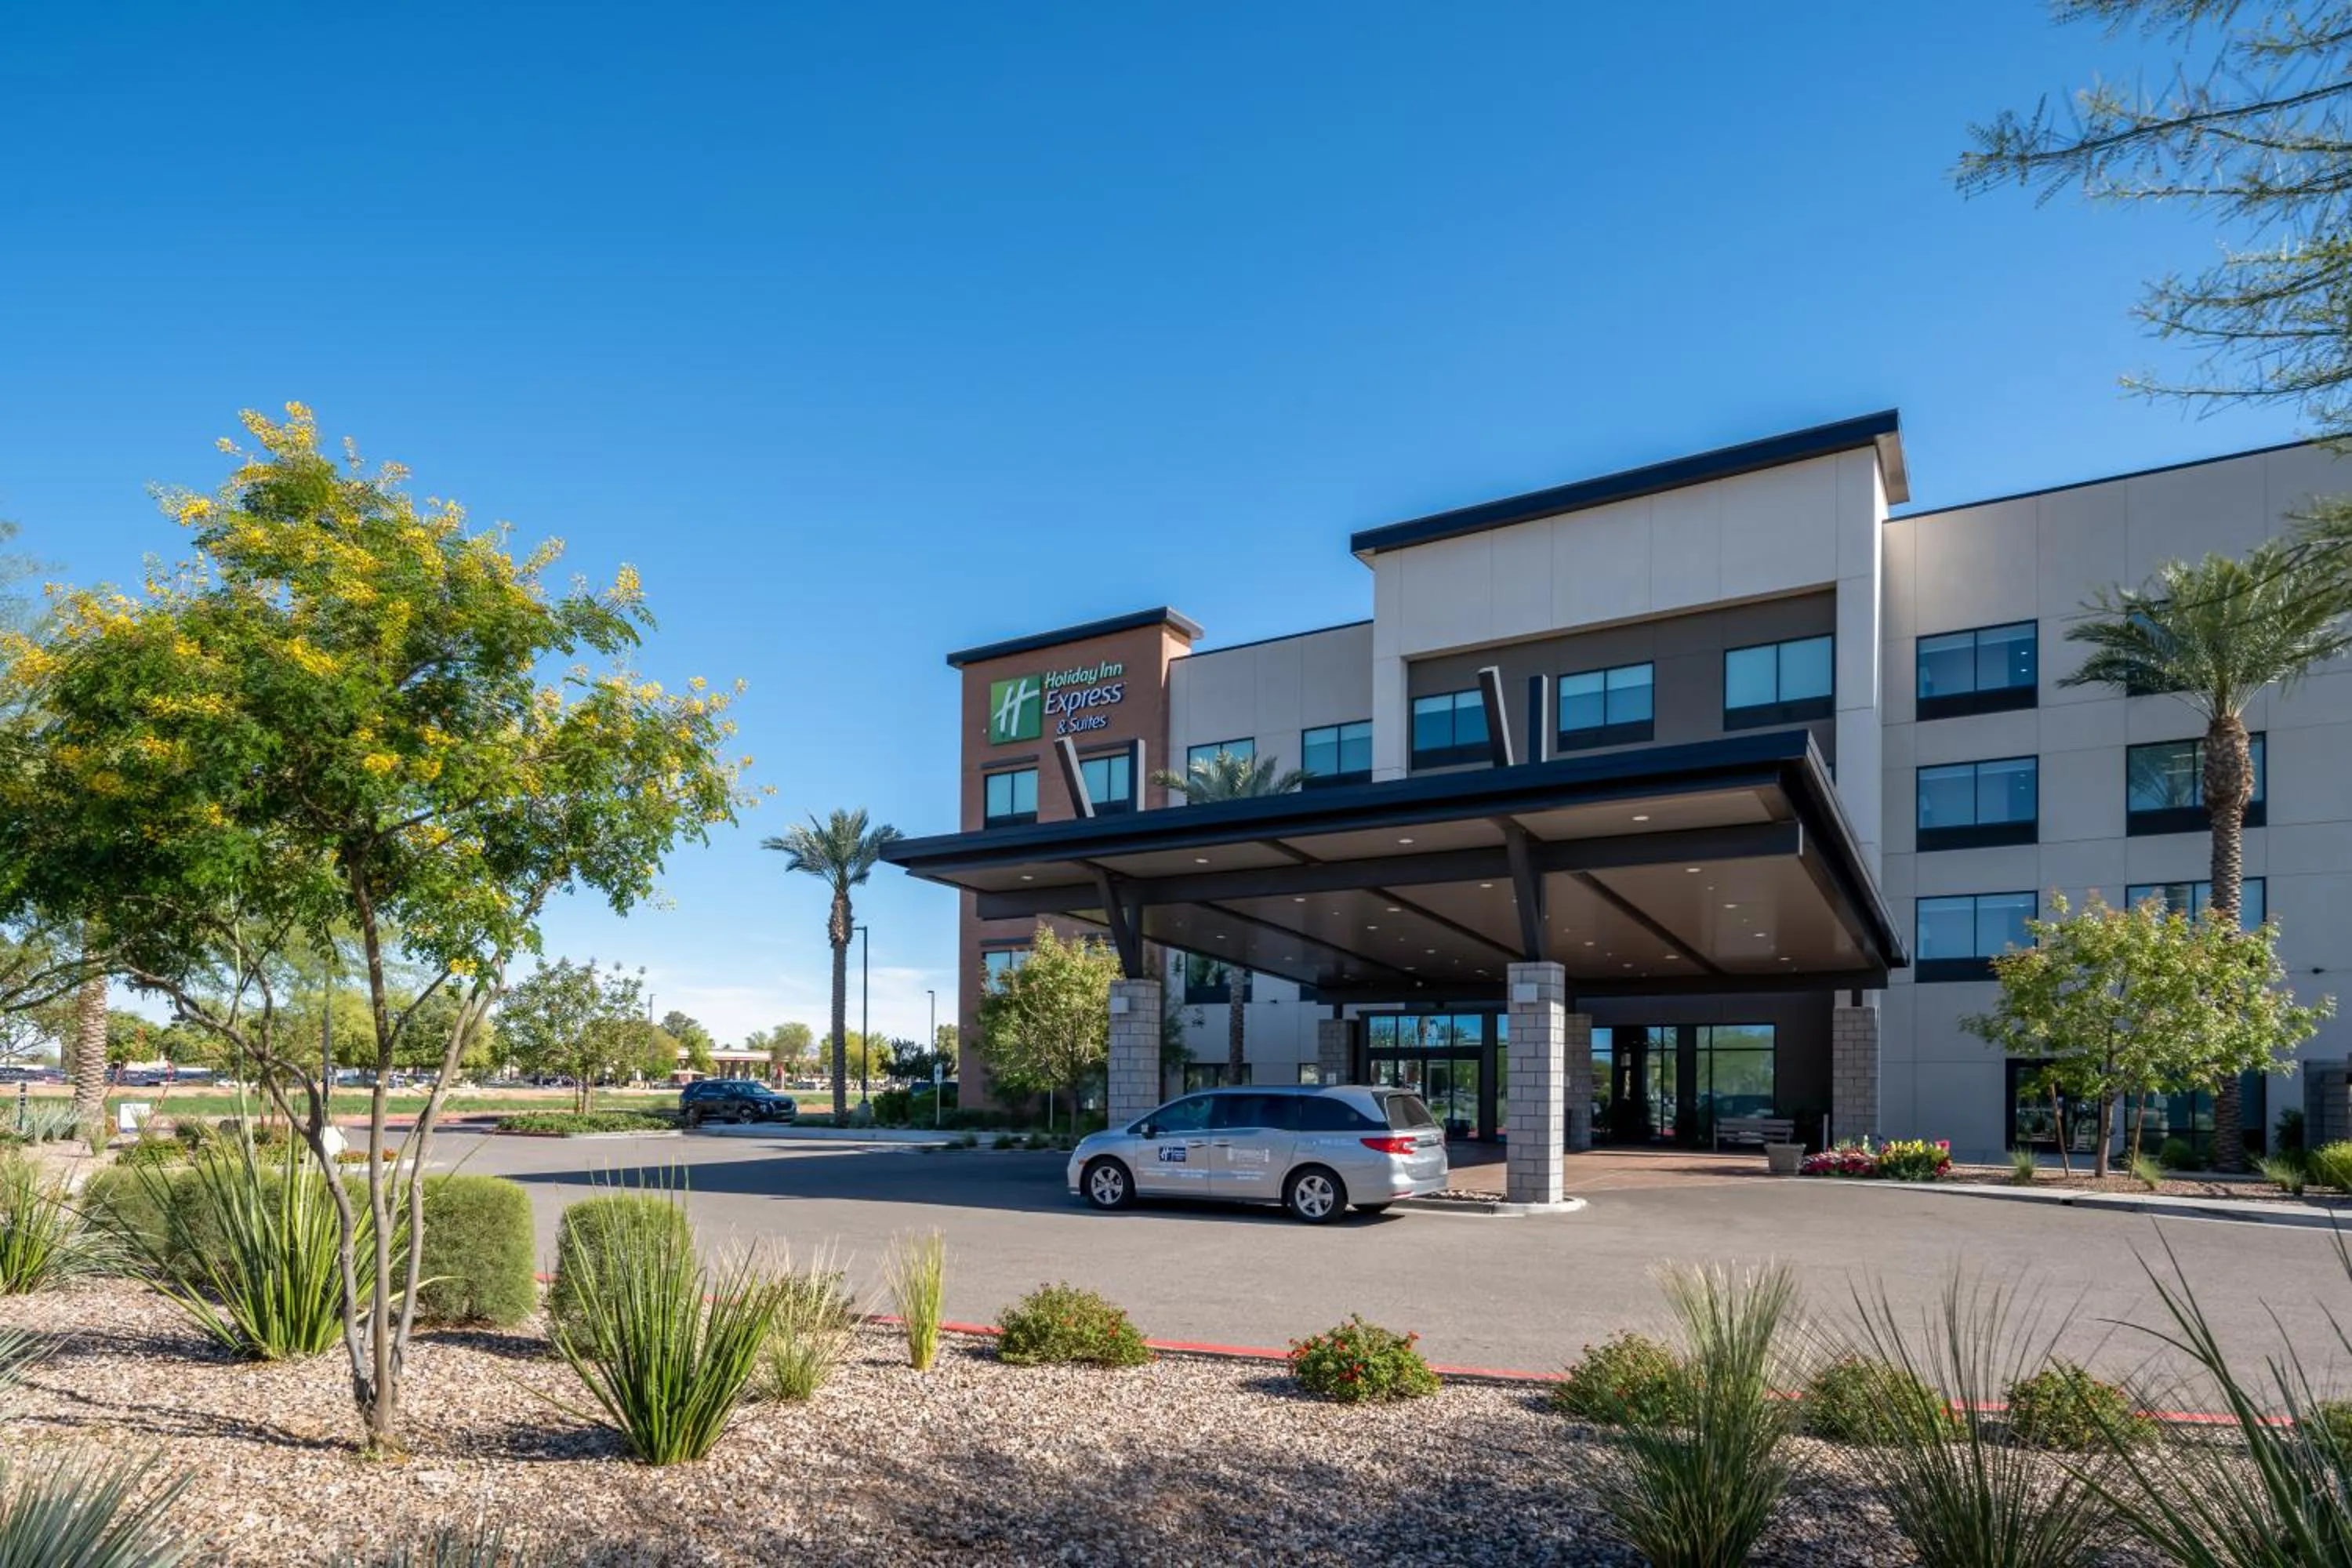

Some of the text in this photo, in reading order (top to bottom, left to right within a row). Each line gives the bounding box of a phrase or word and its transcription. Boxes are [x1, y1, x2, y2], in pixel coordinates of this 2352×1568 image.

[1045, 660, 1122, 689] Holiday Inn
[1045, 683, 1122, 717] Express
[1056, 714, 1106, 735] & Suites
